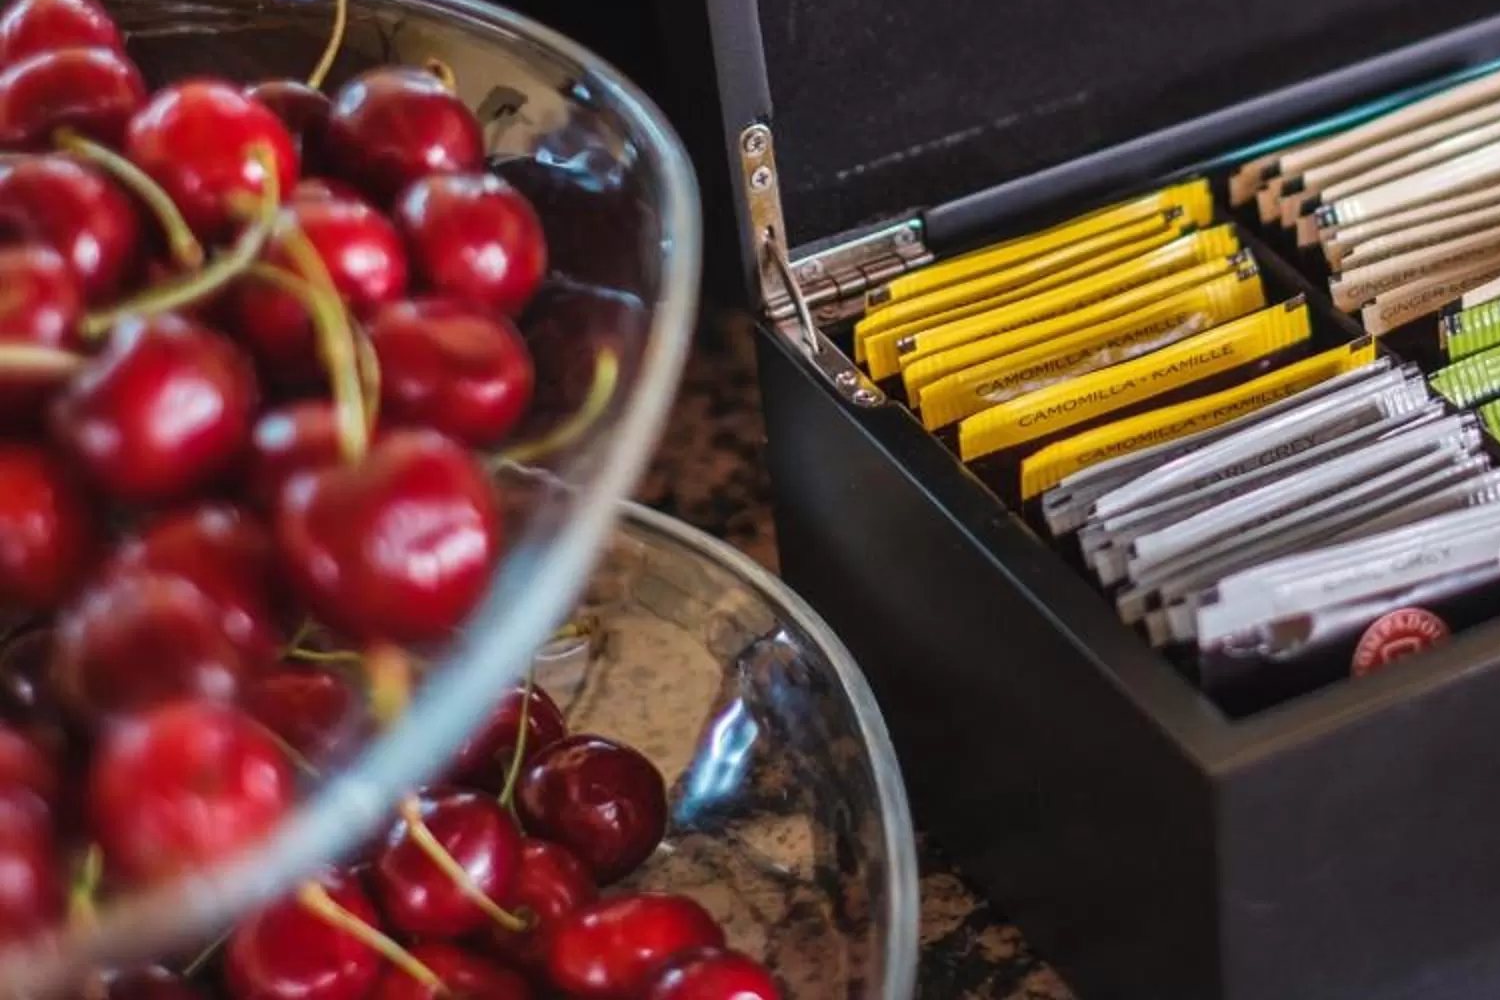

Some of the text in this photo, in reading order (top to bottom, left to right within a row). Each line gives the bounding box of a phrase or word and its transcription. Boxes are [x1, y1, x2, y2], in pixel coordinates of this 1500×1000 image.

[1380, 287, 1445, 321] GINGER
[976, 347, 1091, 396] CAMOMILLA
[1106, 311, 1189, 349] KAMILLE
[1018, 378, 1136, 428] CAMOMILLA
[1152, 342, 1234, 381] KAMILLE
[1077, 417, 1199, 466] CAMOMILLA
[1211, 382, 1298, 421] KAMILLE
[1259, 434, 1316, 467] GREY
